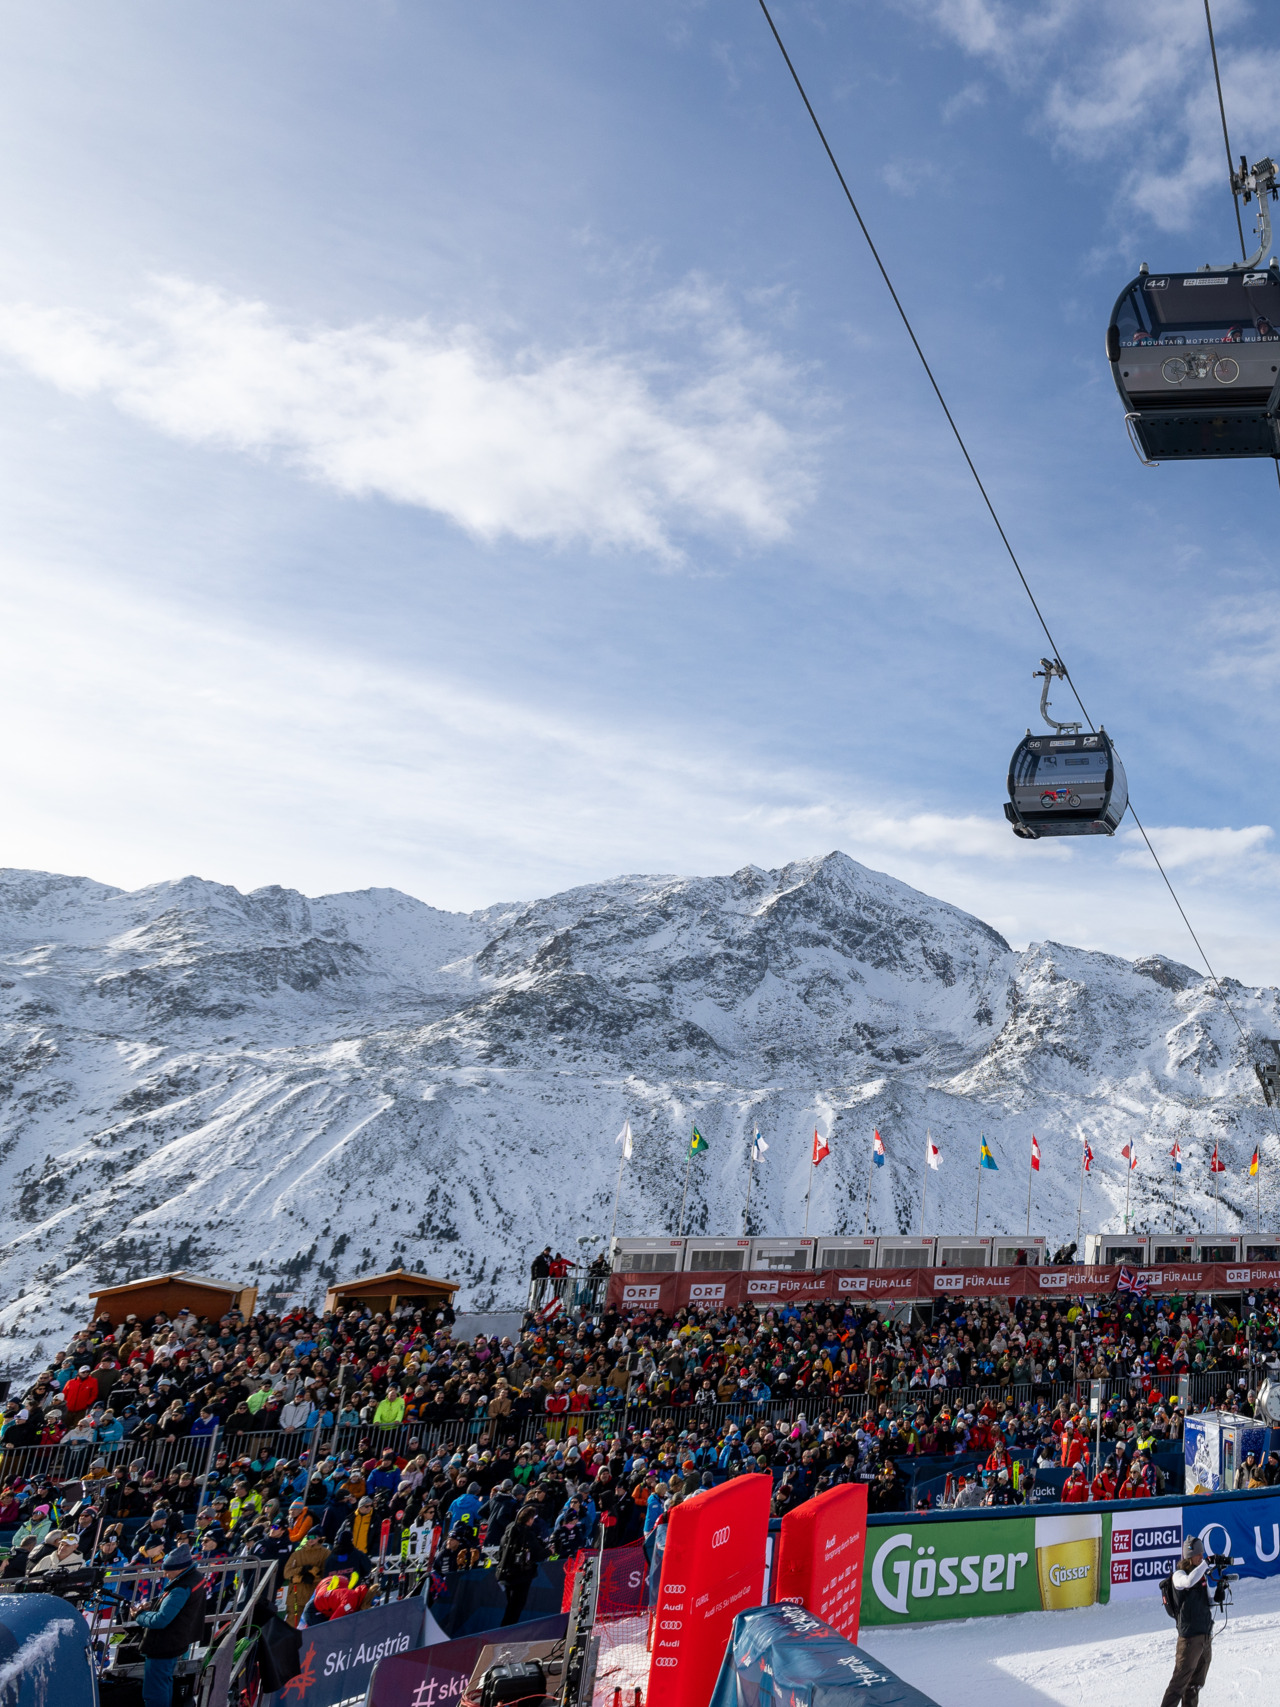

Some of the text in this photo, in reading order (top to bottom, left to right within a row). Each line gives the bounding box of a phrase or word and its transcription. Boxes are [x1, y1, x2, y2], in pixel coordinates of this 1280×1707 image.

[1147, 279, 1165, 288] 44
[1140, 338, 1183, 347] MOUNTAIN
[1186, 336, 1241, 344] MOTORCYCLE
[1041, 1273, 1110, 1285] ORF FÜR ALLE
[1139, 1272, 1202, 1282] ORF FÜR ALLE
[1228, 1272, 1249, 1280] ORF
[1252, 1269, 1267, 1279] FÜR
[750, 1281, 826, 1291] ORF FÜR ALLE
[841, 1278, 912, 1288] ORF FÜR ALLE
[936, 1276, 1010, 1287] ORF FÜR ALLE
[626, 1288, 658, 1298] ORF
[693, 1287, 723, 1296] ORF
[638, 1301, 659, 1309] ALLE
[704, 1300, 724, 1308] ALLE
[825, 1534, 836, 1550] Audi
[1114, 1530, 1180, 1547] ÖTZ GURGL
[1114, 1542, 1129, 1551] TAL
[1113, 1562, 1129, 1572] ÖTZ
[872, 1533, 1029, 1614] Gösser
[1050, 1563, 1090, 1587] Gösser
[1113, 1572, 1128, 1581] TAL
[663, 1603, 684, 1611] Audi
[704, 1585, 751, 1620] Audi FIS Ski World Cup
[659, 1640, 680, 1648] Audi
[323, 1632, 410, 1677] Ski Austria
